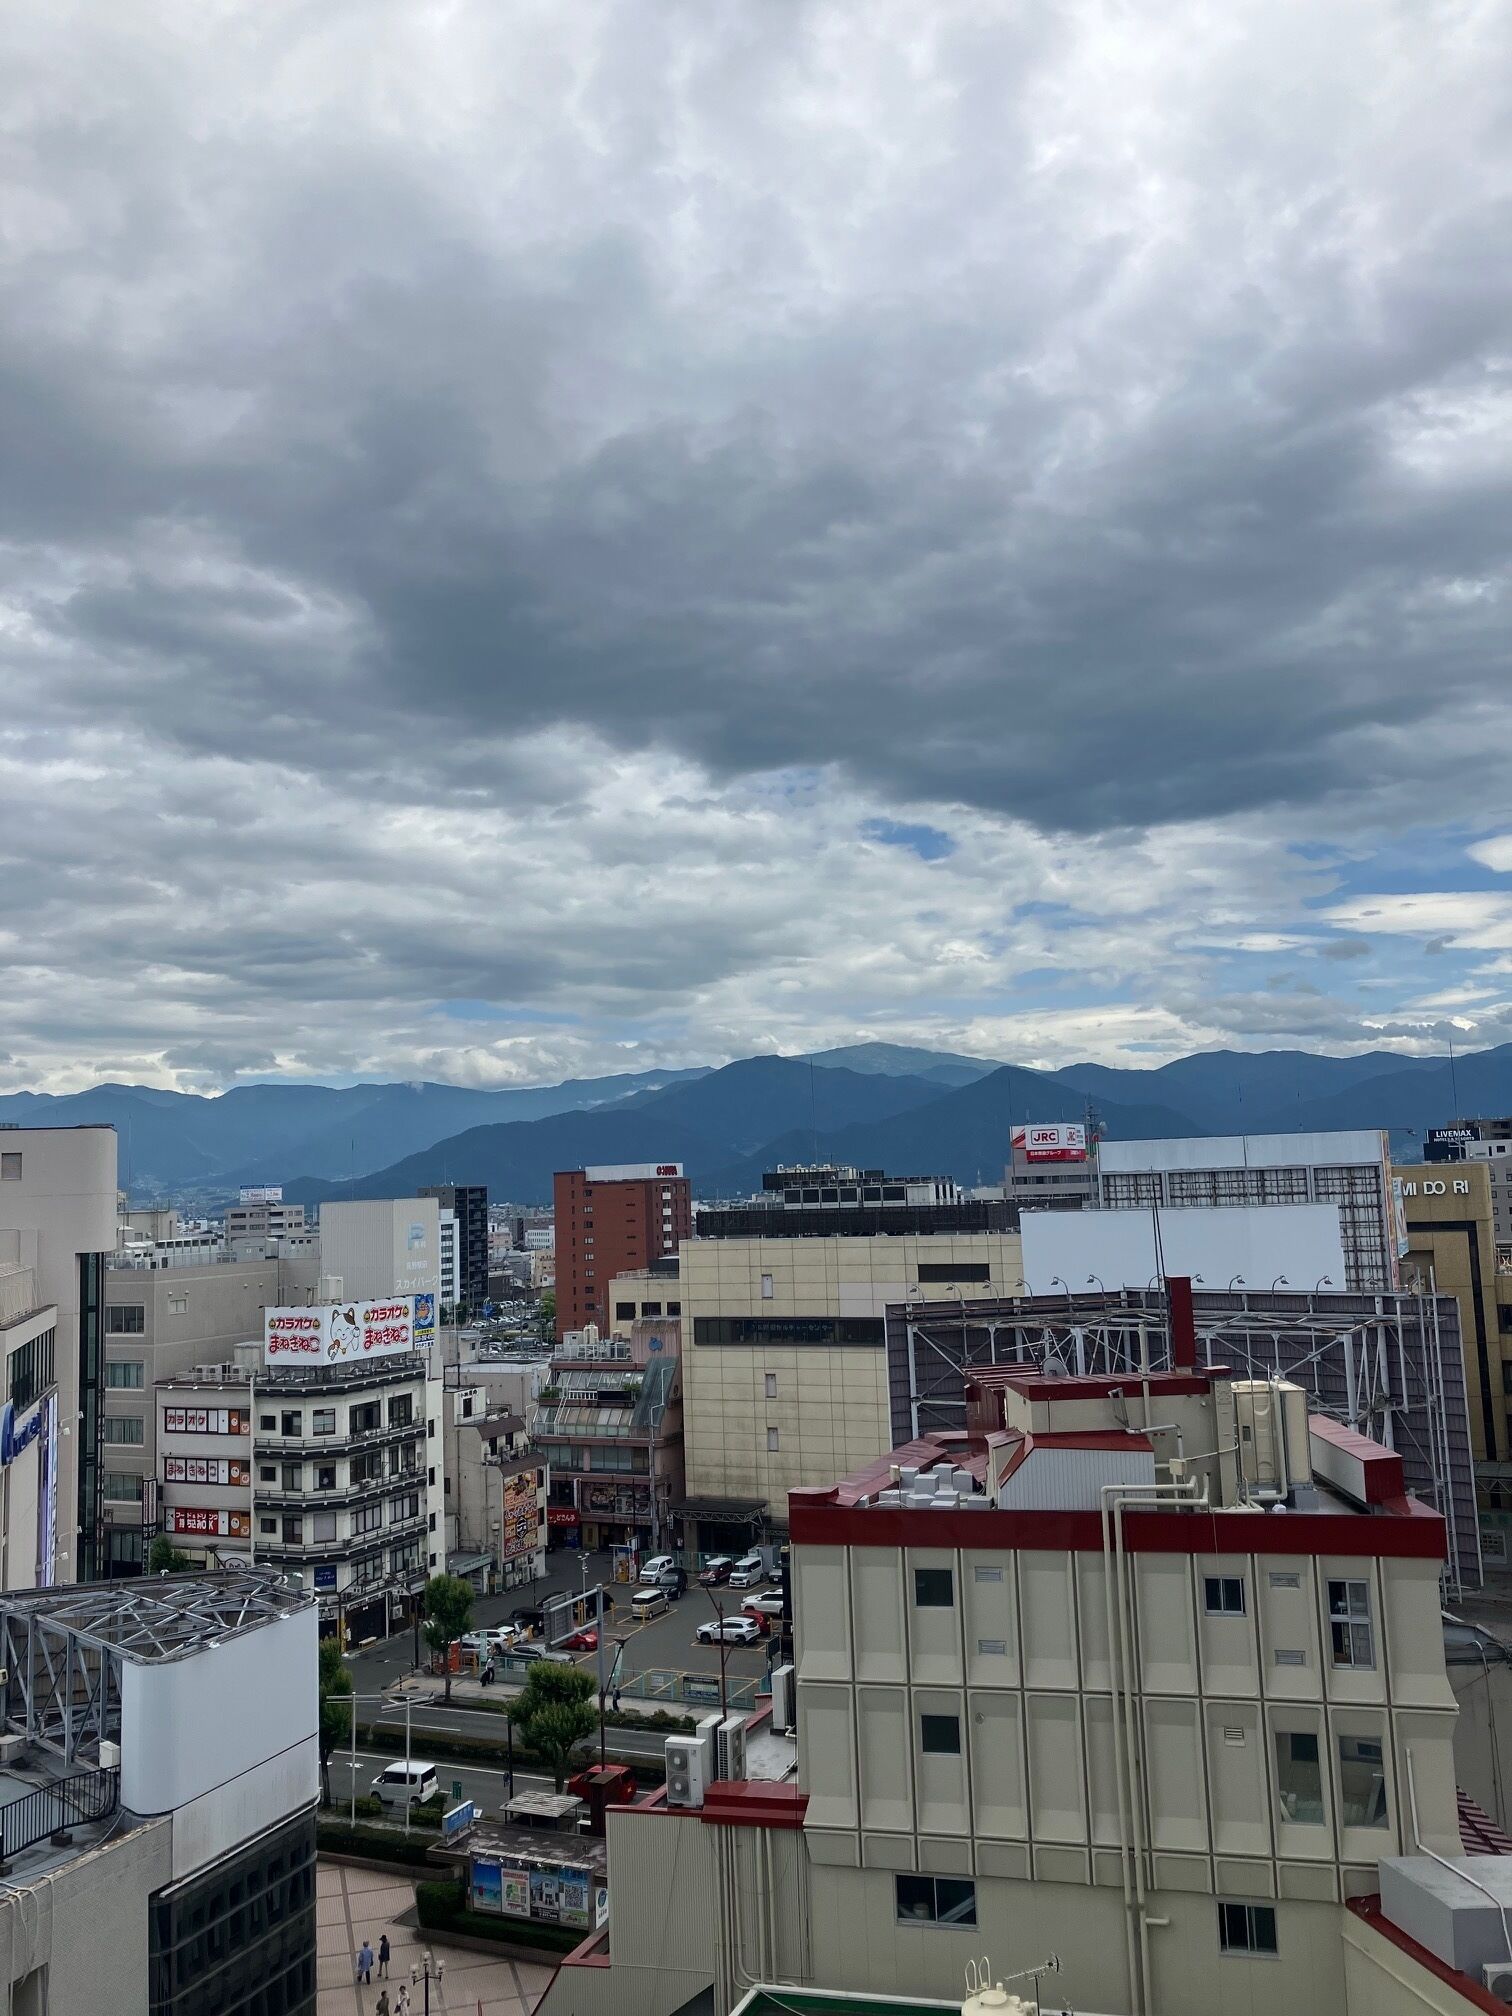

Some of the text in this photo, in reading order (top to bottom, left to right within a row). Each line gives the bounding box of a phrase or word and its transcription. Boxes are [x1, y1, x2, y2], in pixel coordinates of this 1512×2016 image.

[1033, 1132, 1056, 1142] JRC
[1436, 1129, 1472, 1138] LIVEMAX
[1423, 1181, 1446, 1194] DO
[1453, 1180, 1469, 1194] RI
[369, 1304, 402, 1322] カラオケ
[275, 1317, 313, 1330] カラオケ
[268, 1332, 321, 1355] まねきねこ
[364, 1324, 409, 1352] まねきねこ
[168, 1414, 206, 1425] カラオケ
[168, 1462, 216, 1477] まねきねこ
